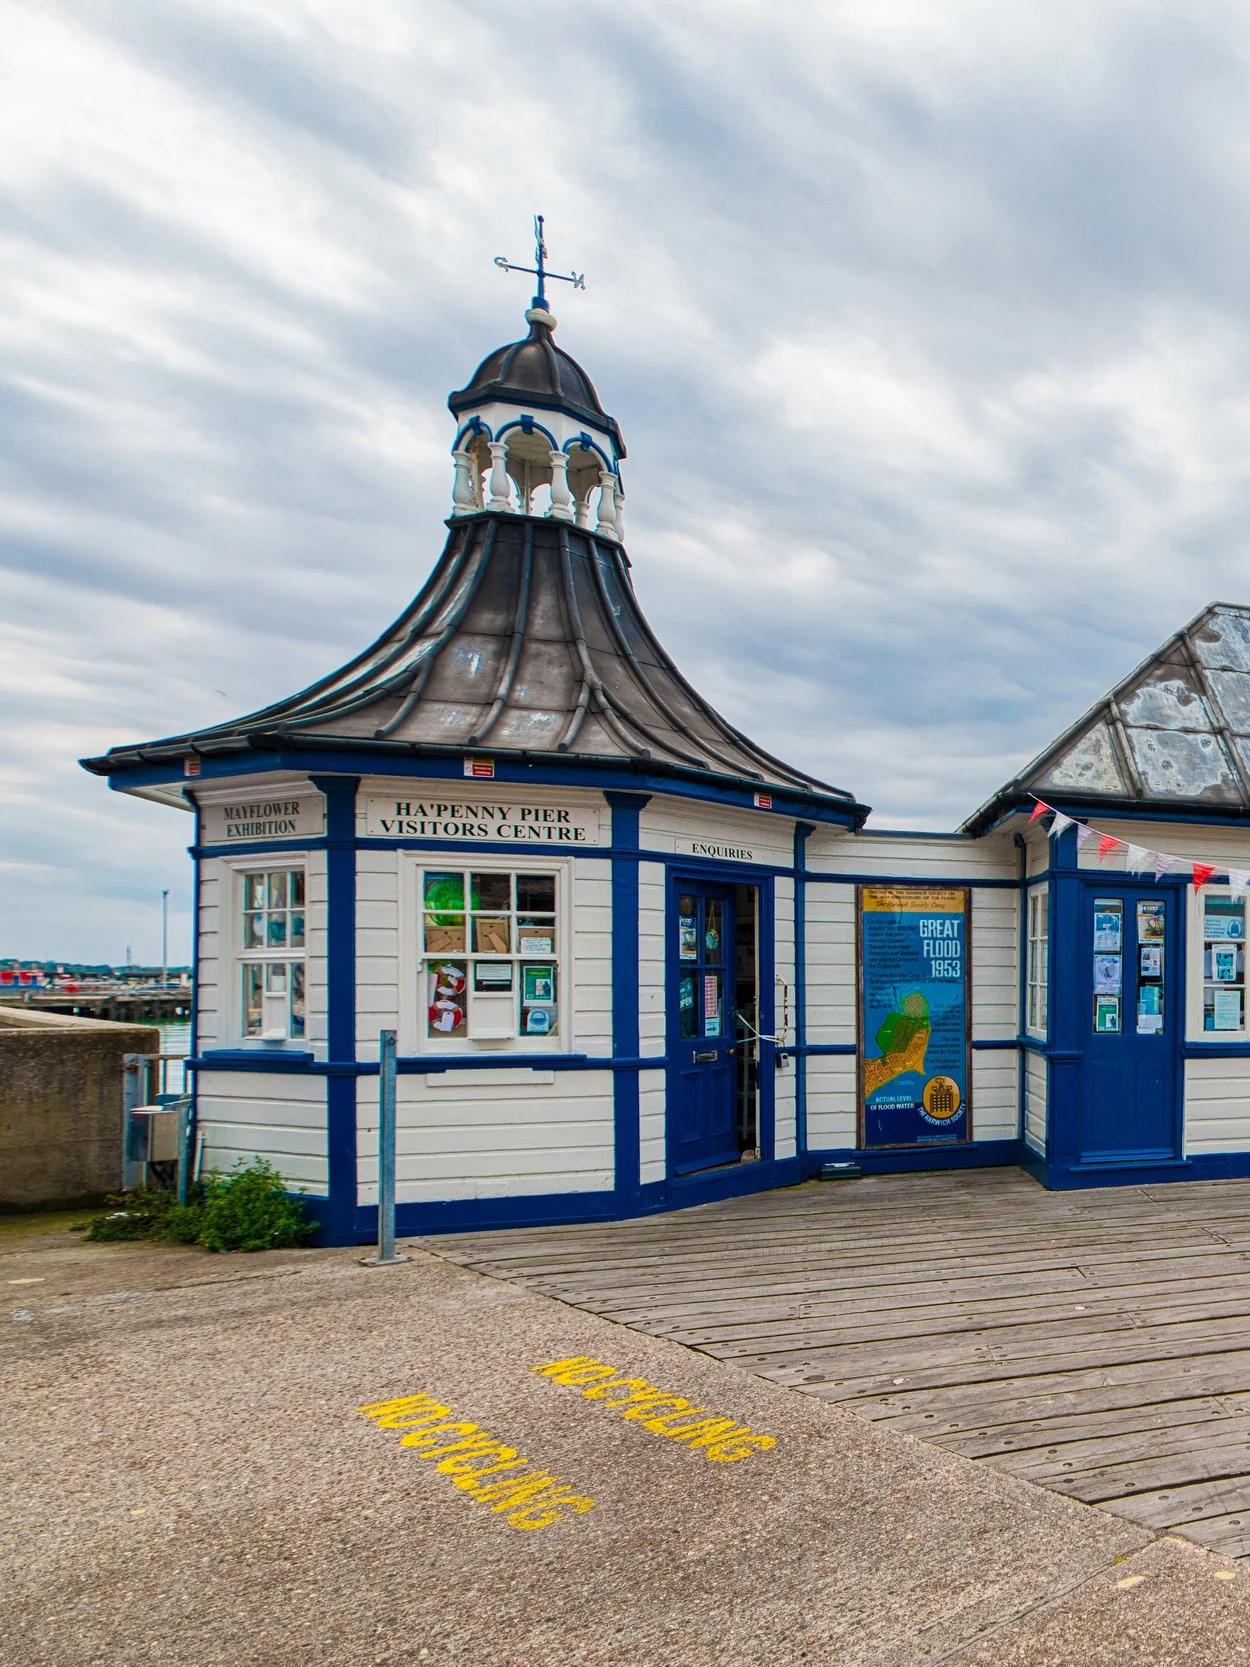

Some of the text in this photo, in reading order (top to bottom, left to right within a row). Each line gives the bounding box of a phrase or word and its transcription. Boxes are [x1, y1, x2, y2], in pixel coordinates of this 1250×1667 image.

[224, 801, 300, 820] MAYFLOWER
[395, 802, 570, 823] HA'PENNY PIER
[227, 819, 297, 837] EXHIBITION
[379, 819, 586, 841] VISITORS CENTRE
[692, 843, 753, 860] ENQUIRIES
[920, 920, 960, 938] GREAT
[923, 940, 960, 958] FLOOD
[930, 960, 960, 978] 1953
[917, 1102, 966, 1126] THE HARWICH SOCIETY
[530, 1355, 778, 1464] NO CYCLING
[357, 1393, 596, 1531] NO CYCLING
